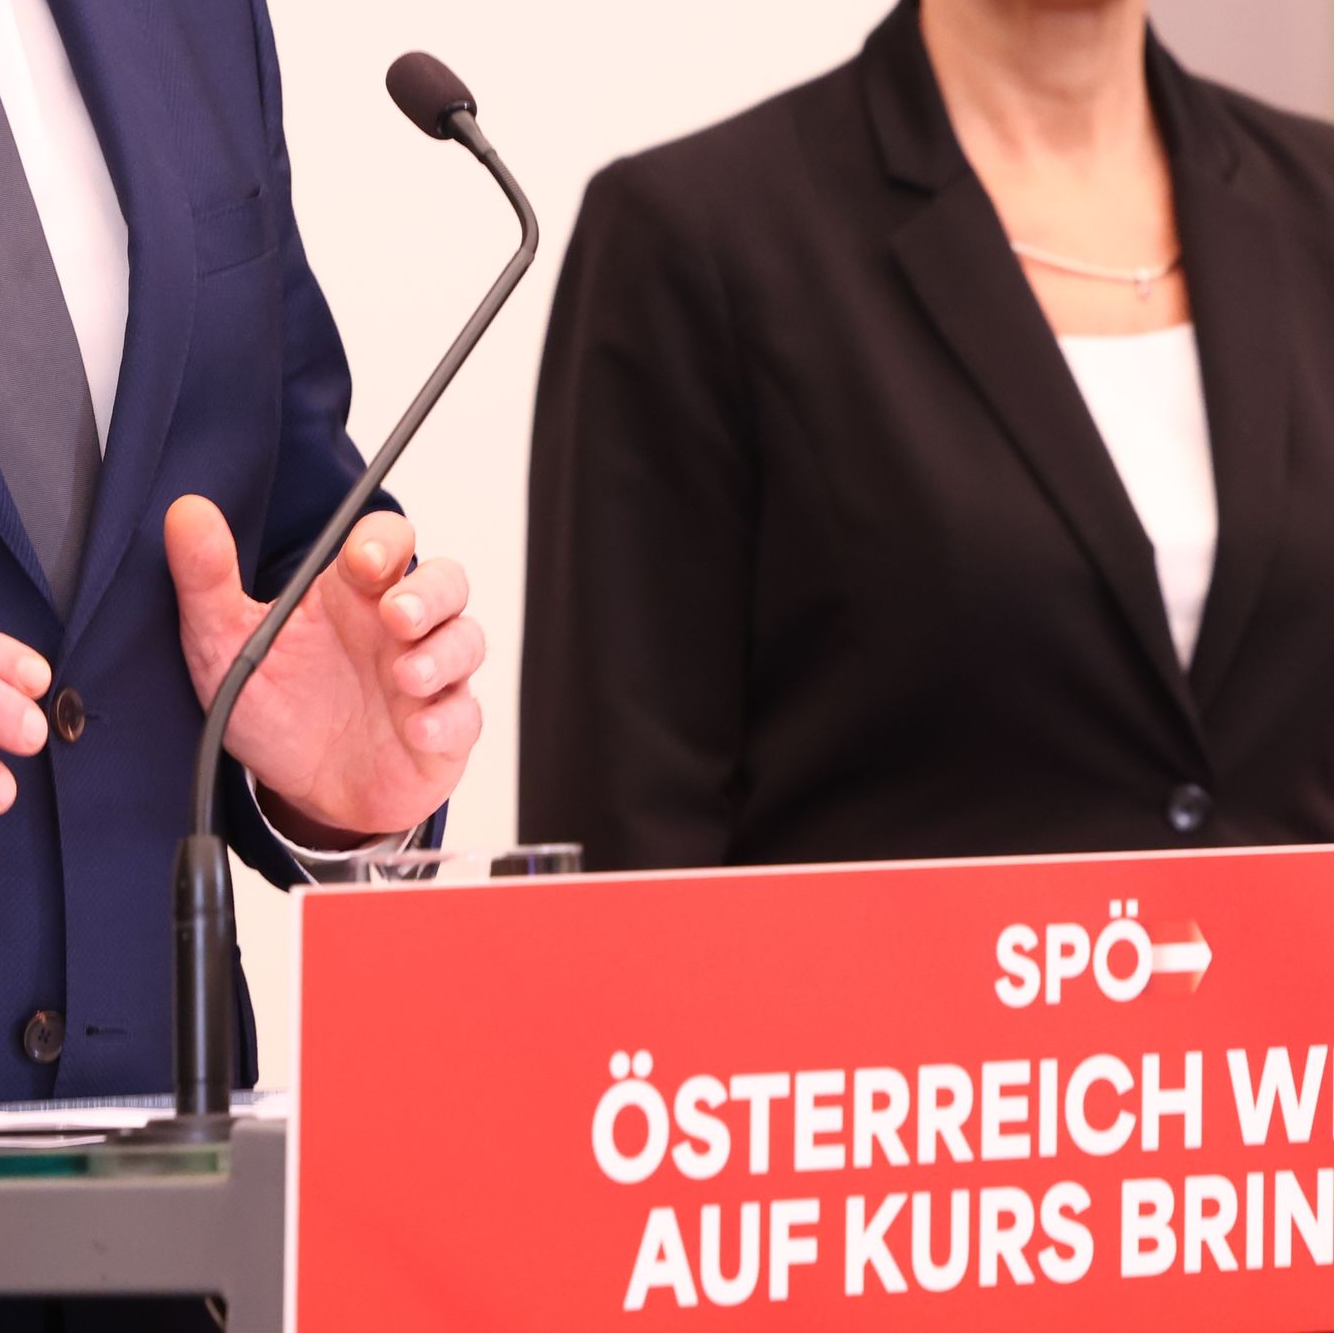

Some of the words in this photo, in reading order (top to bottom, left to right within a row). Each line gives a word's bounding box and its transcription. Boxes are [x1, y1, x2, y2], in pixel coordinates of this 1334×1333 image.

[994, 898, 1154, 1008] SPÖ
[591, 1049, 1203, 1184] ÖSTERREICH
[623, 1198, 820, 1311] AUF
[844, 1181, 1094, 1296] KURS
